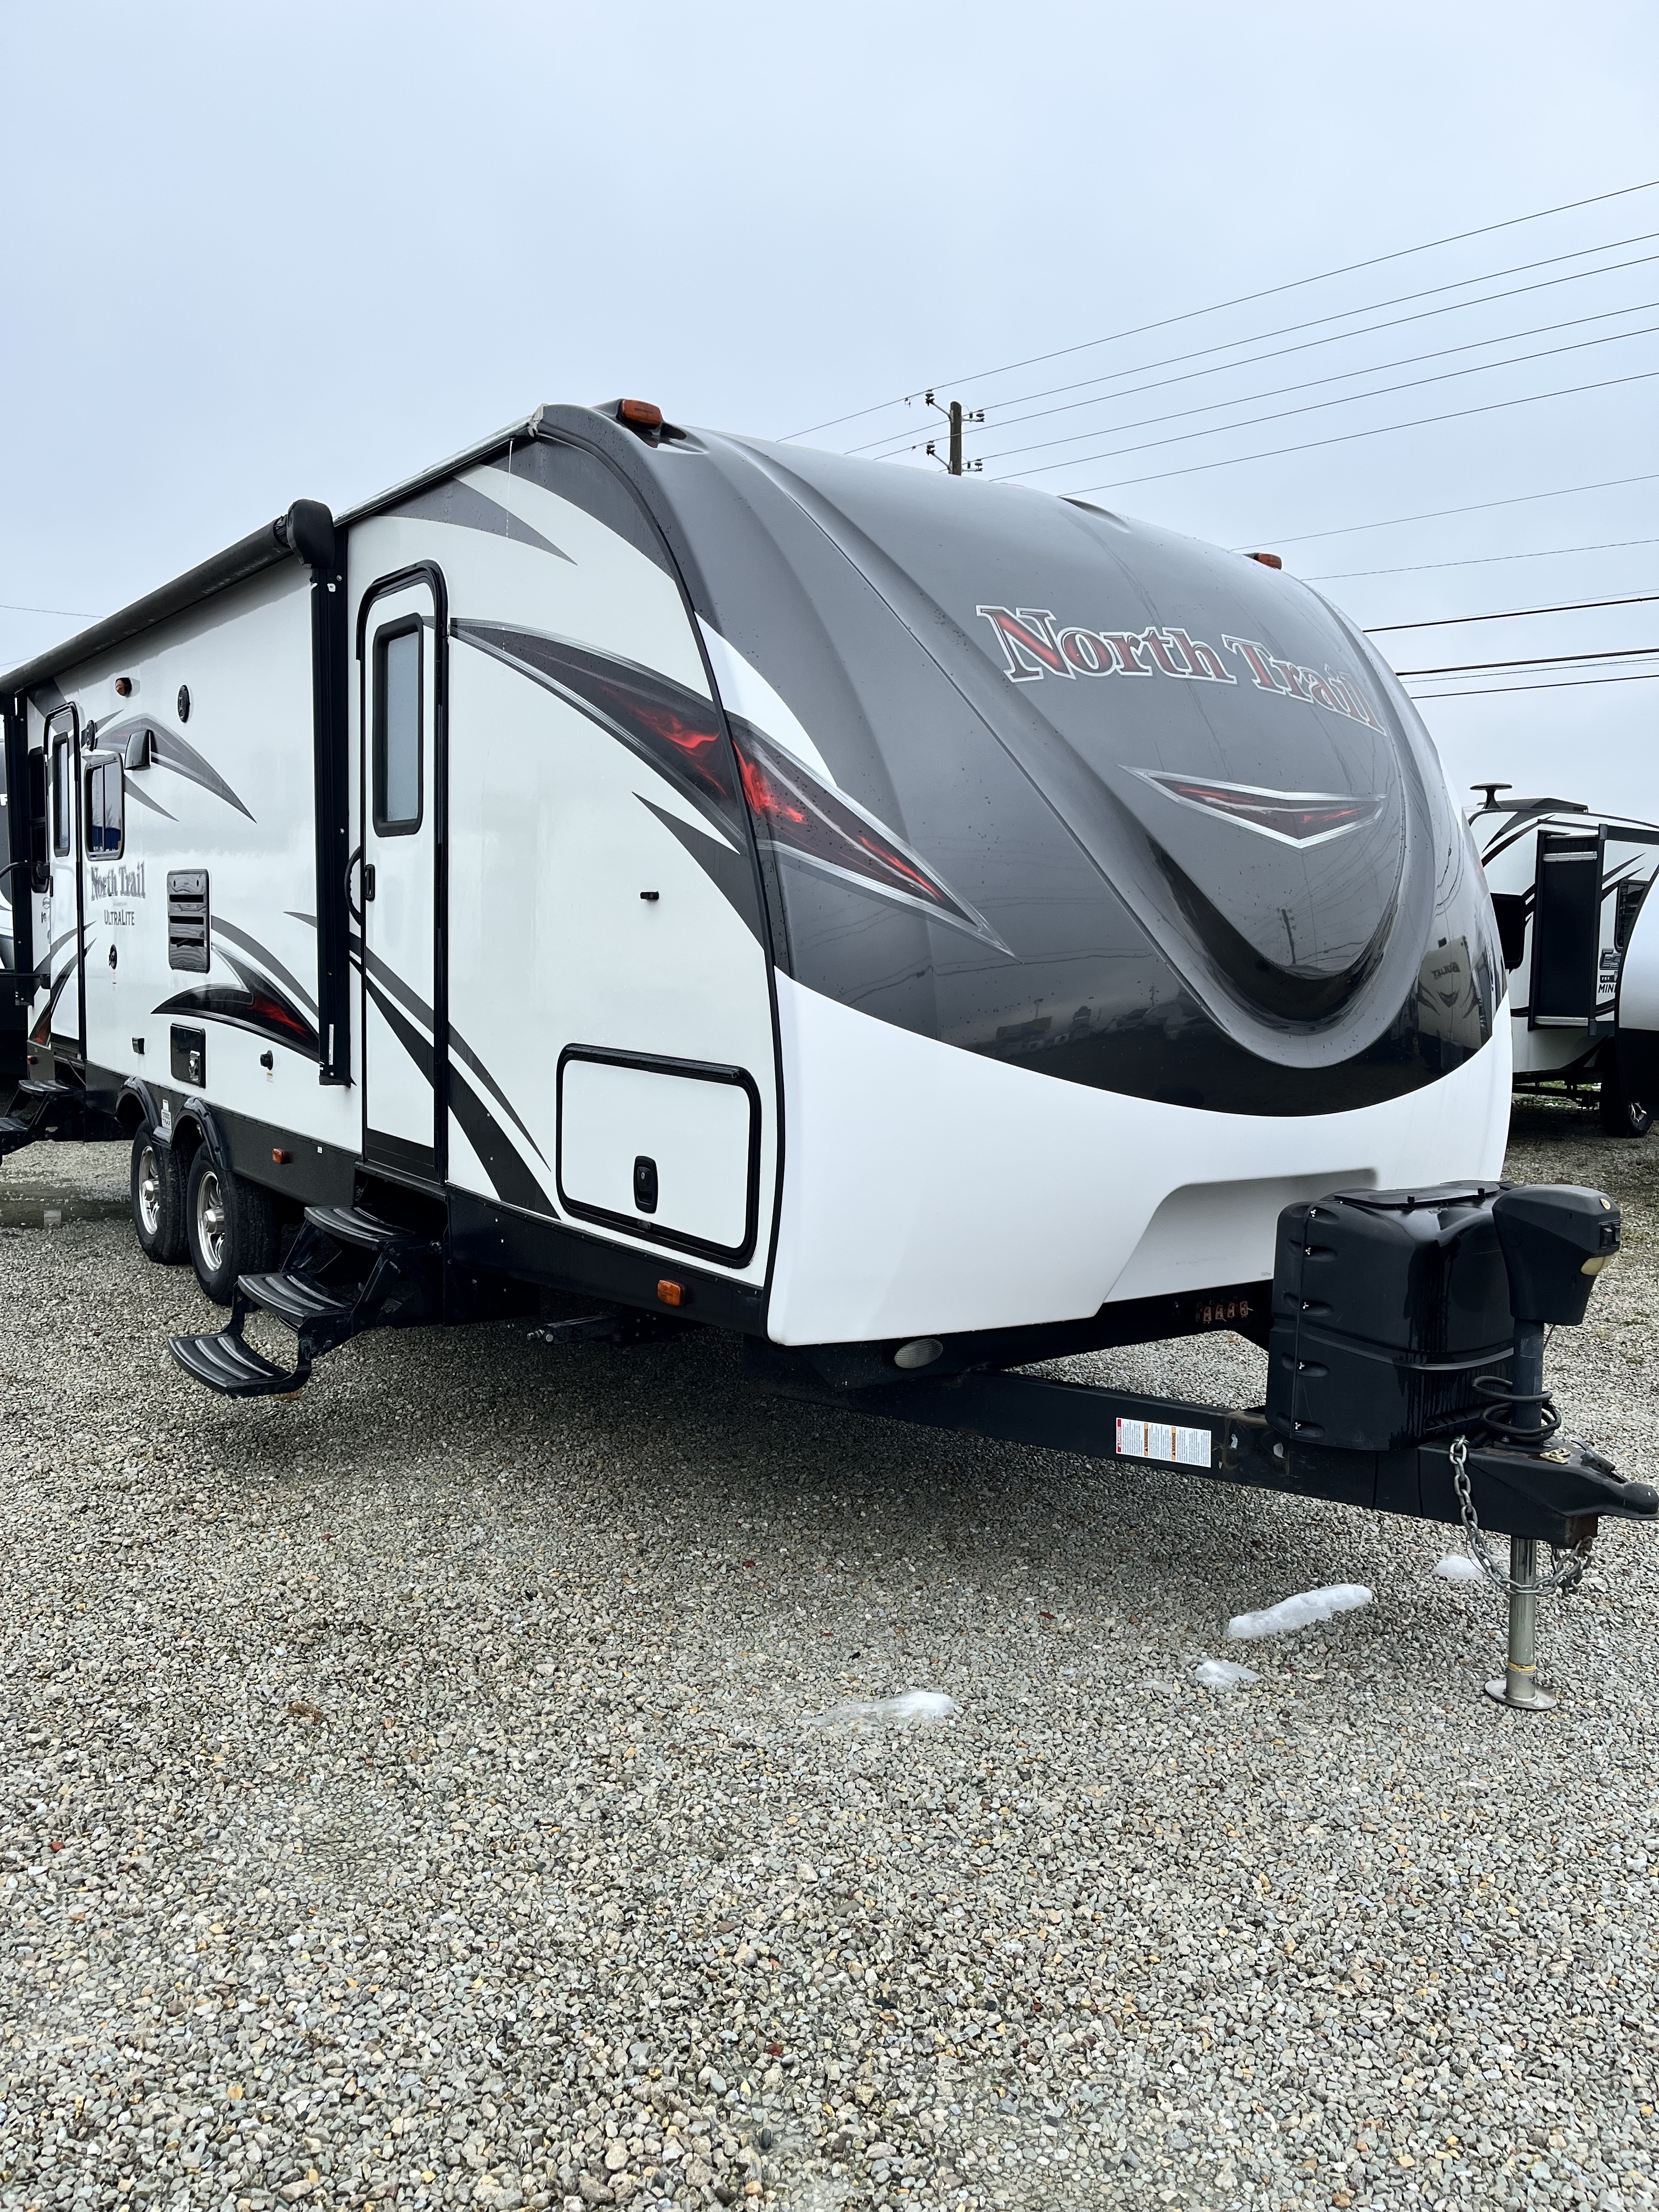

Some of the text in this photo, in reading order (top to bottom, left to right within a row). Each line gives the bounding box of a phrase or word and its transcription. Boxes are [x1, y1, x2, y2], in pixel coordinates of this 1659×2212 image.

[975, 605, 1387, 736] North Trail
[91, 861, 146, 901] North Trail
